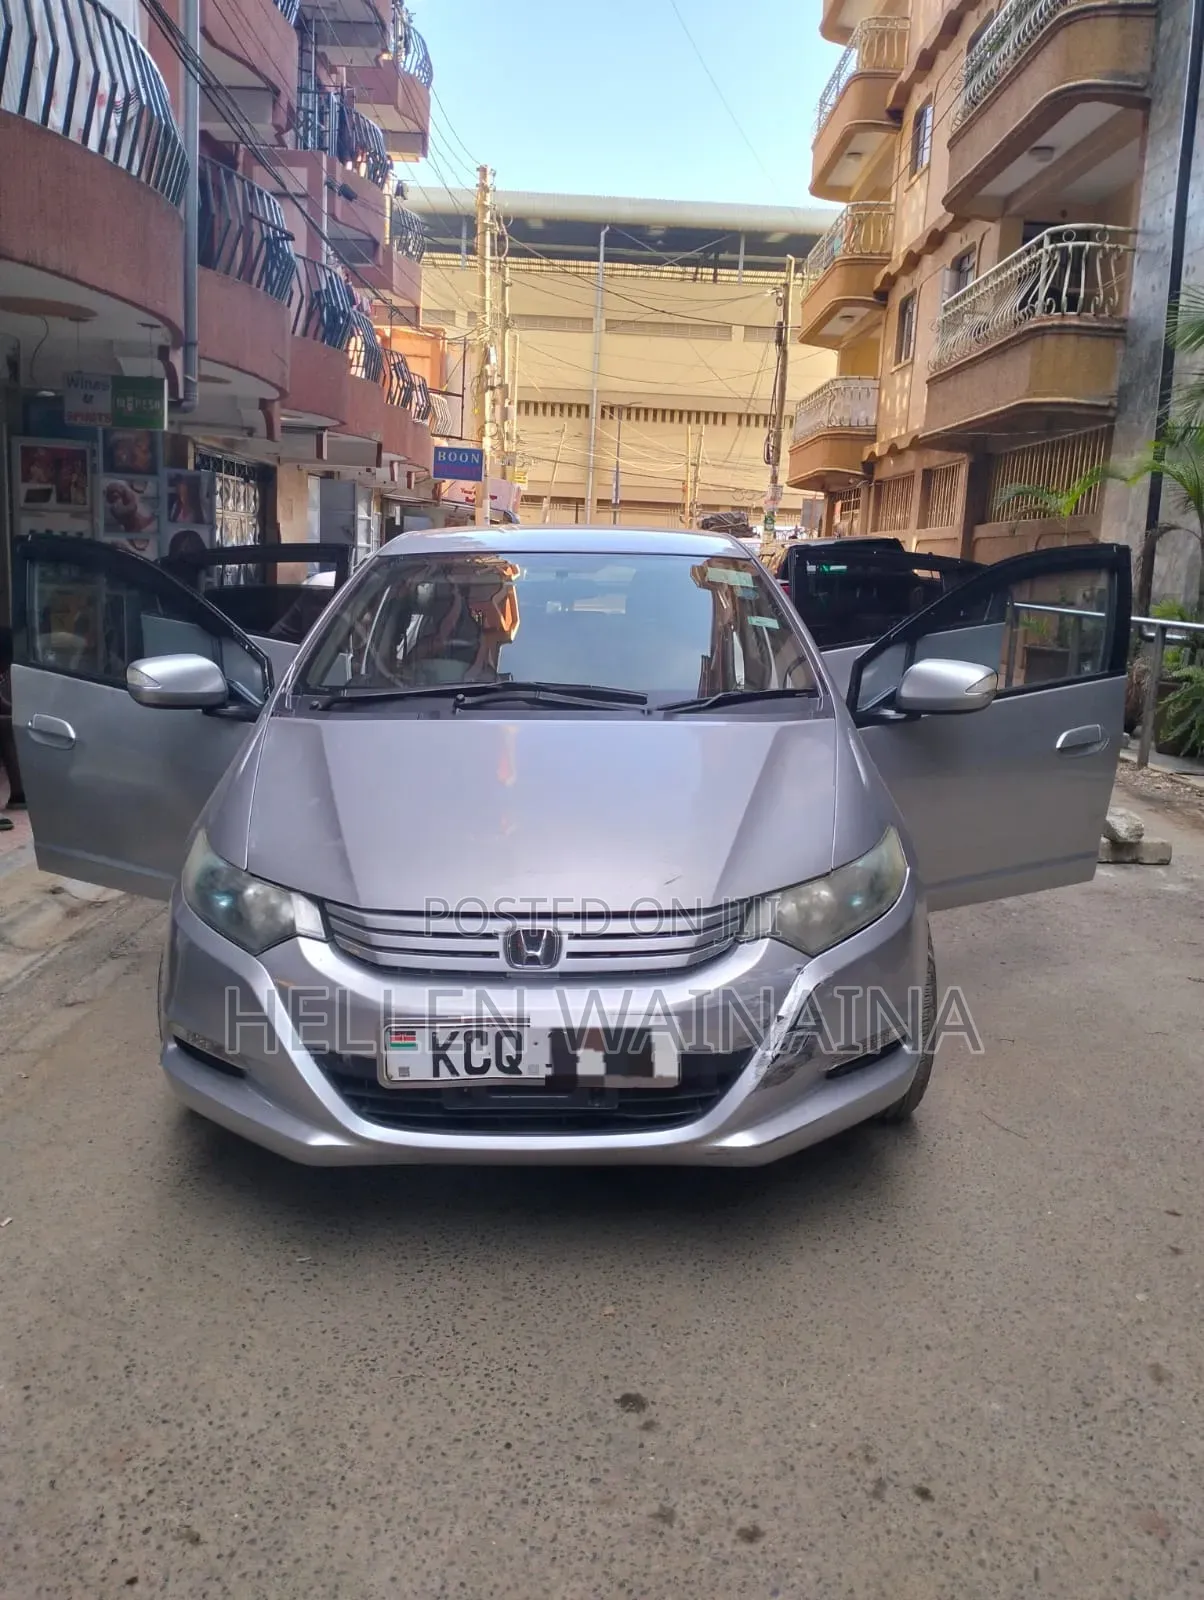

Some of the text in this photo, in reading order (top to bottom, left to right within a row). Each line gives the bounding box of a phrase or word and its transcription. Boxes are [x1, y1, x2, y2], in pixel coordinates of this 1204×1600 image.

[67, 375, 110, 391] Wines
[438, 451, 480, 464] BOON
[431, 1028, 523, 1077] KCQ
